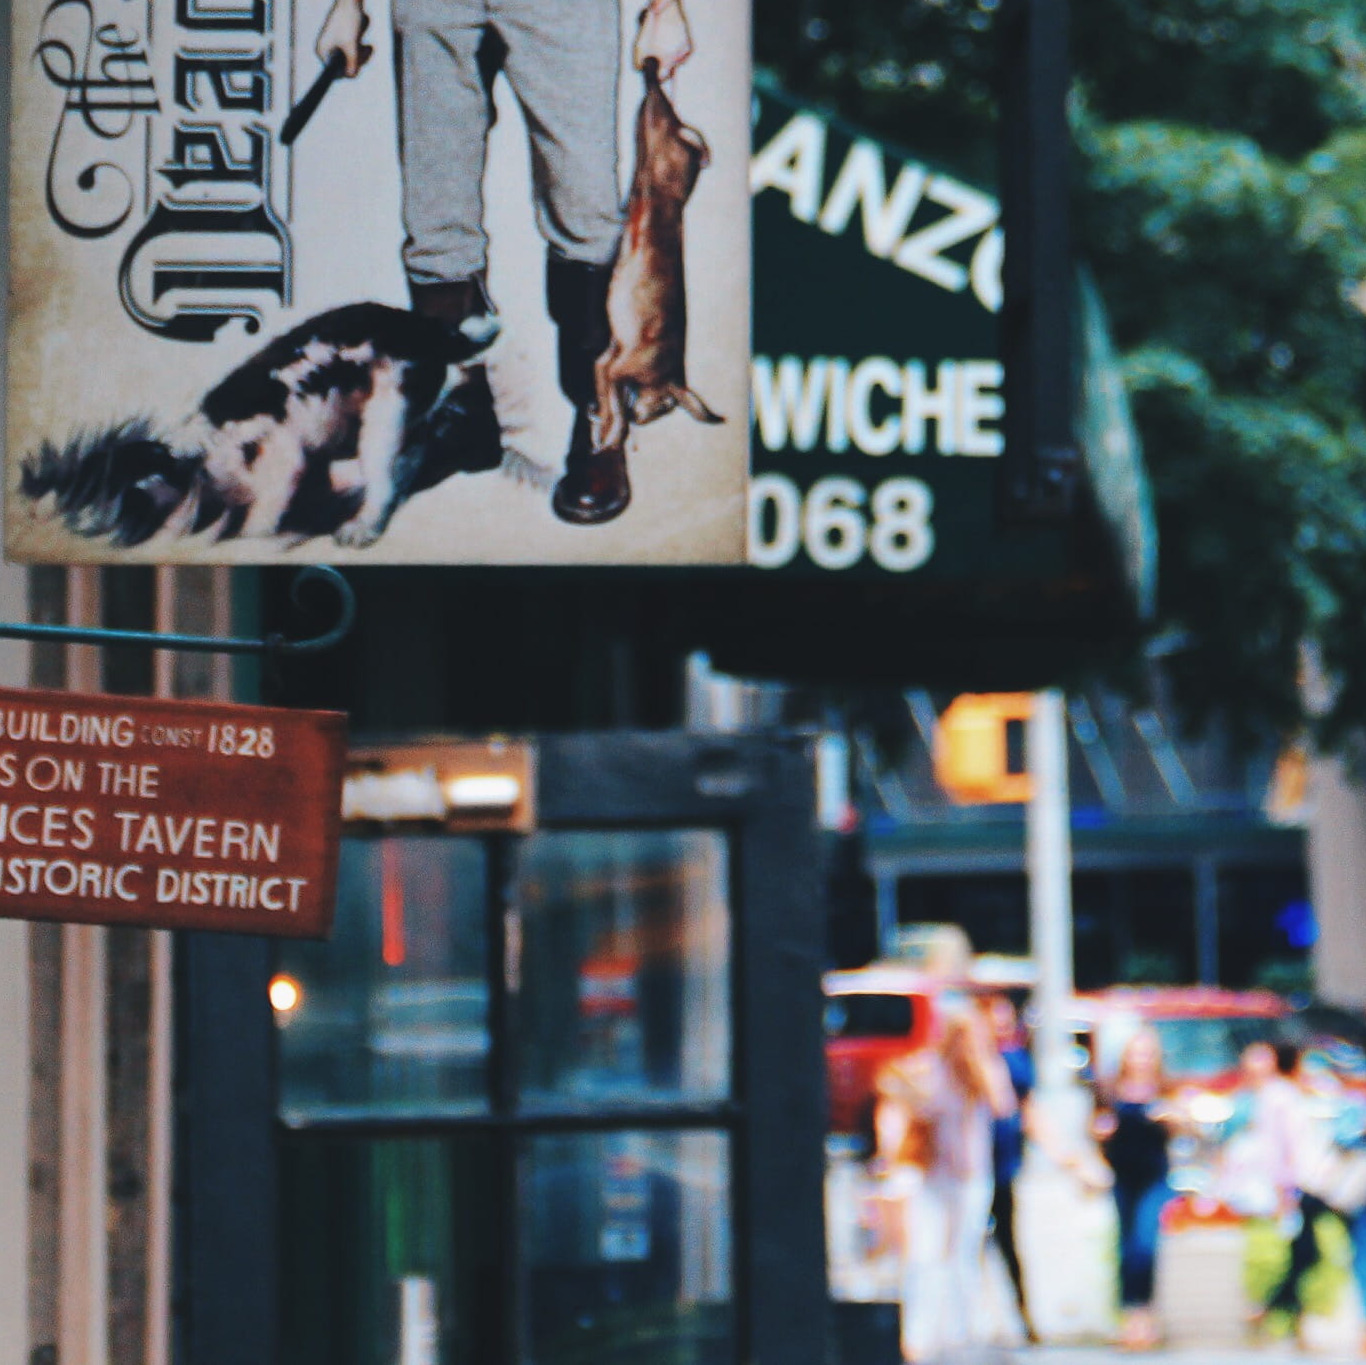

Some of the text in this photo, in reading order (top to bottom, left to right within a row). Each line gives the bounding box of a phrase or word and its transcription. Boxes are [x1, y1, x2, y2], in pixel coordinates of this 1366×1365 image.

[749, 472, 935, 572] 068
[207, 722, 276, 760] 1828
[25, 755, 85, 792] ON
[97, 760, 161, 799] THE
[114, 811, 281, 864] TAVERN
[156, 867, 308, 913] DISTRICT
